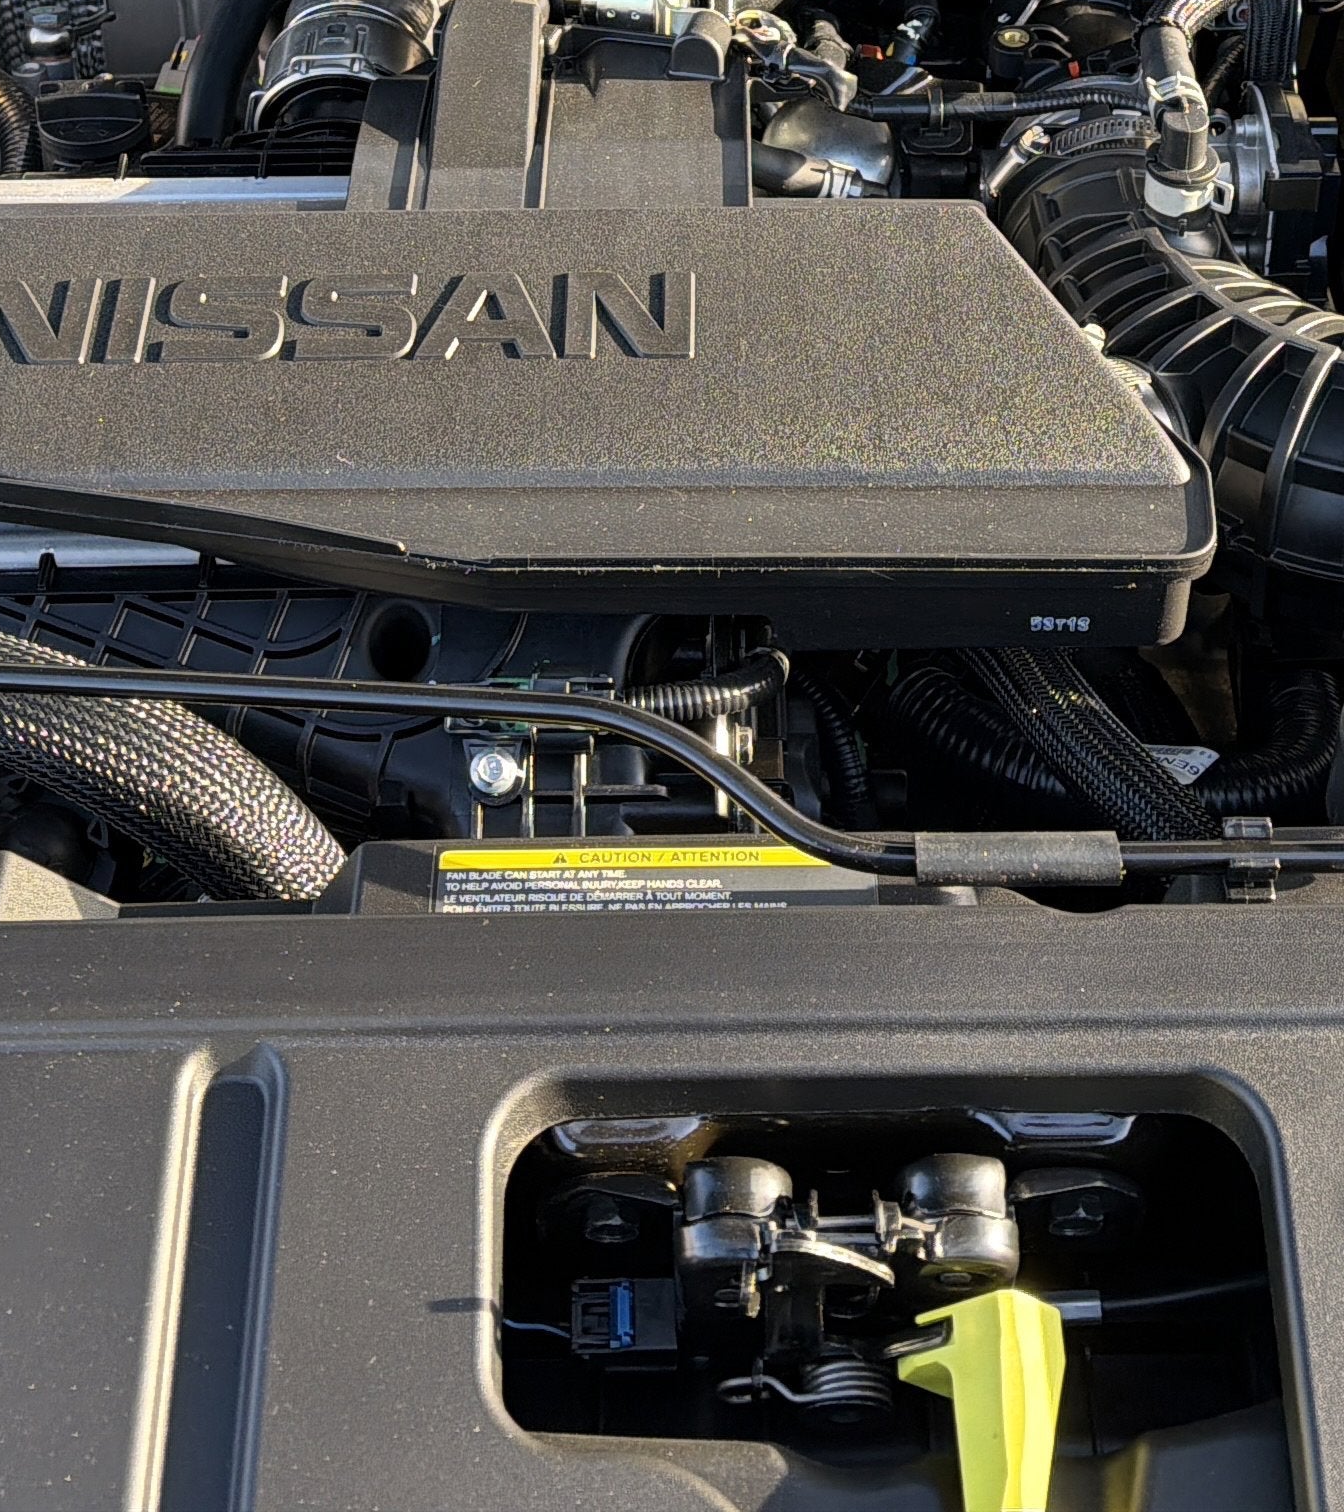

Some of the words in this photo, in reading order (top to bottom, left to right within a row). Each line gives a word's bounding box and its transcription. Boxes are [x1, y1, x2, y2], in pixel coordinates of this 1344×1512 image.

[579, 851, 652, 863] CAUTION
[670, 850, 760, 862] ATTENTION
[446, 871, 467, 880] FAN
[468, 871, 502, 880] BLADE
[504, 870, 528, 880] CAN
[529, 870, 562, 879] START
[563, 870, 576, 879] AT
[577, 869, 600, 879] ANY
[445, 882, 461, 891] TO
[461, 882, 489, 891] HELP
[490, 881, 523, 890] AVOID
[525, 881, 581, 890] PERSONAL
[646, 879, 684, 889] HANDS
[443, 894, 458, 903] LE
[458, 893, 526, 903] VENTILATEUR
[528, 893, 568, 902] RISQUE
[569, 892, 585, 902] DE
[655, 891, 683, 901] TOUT
